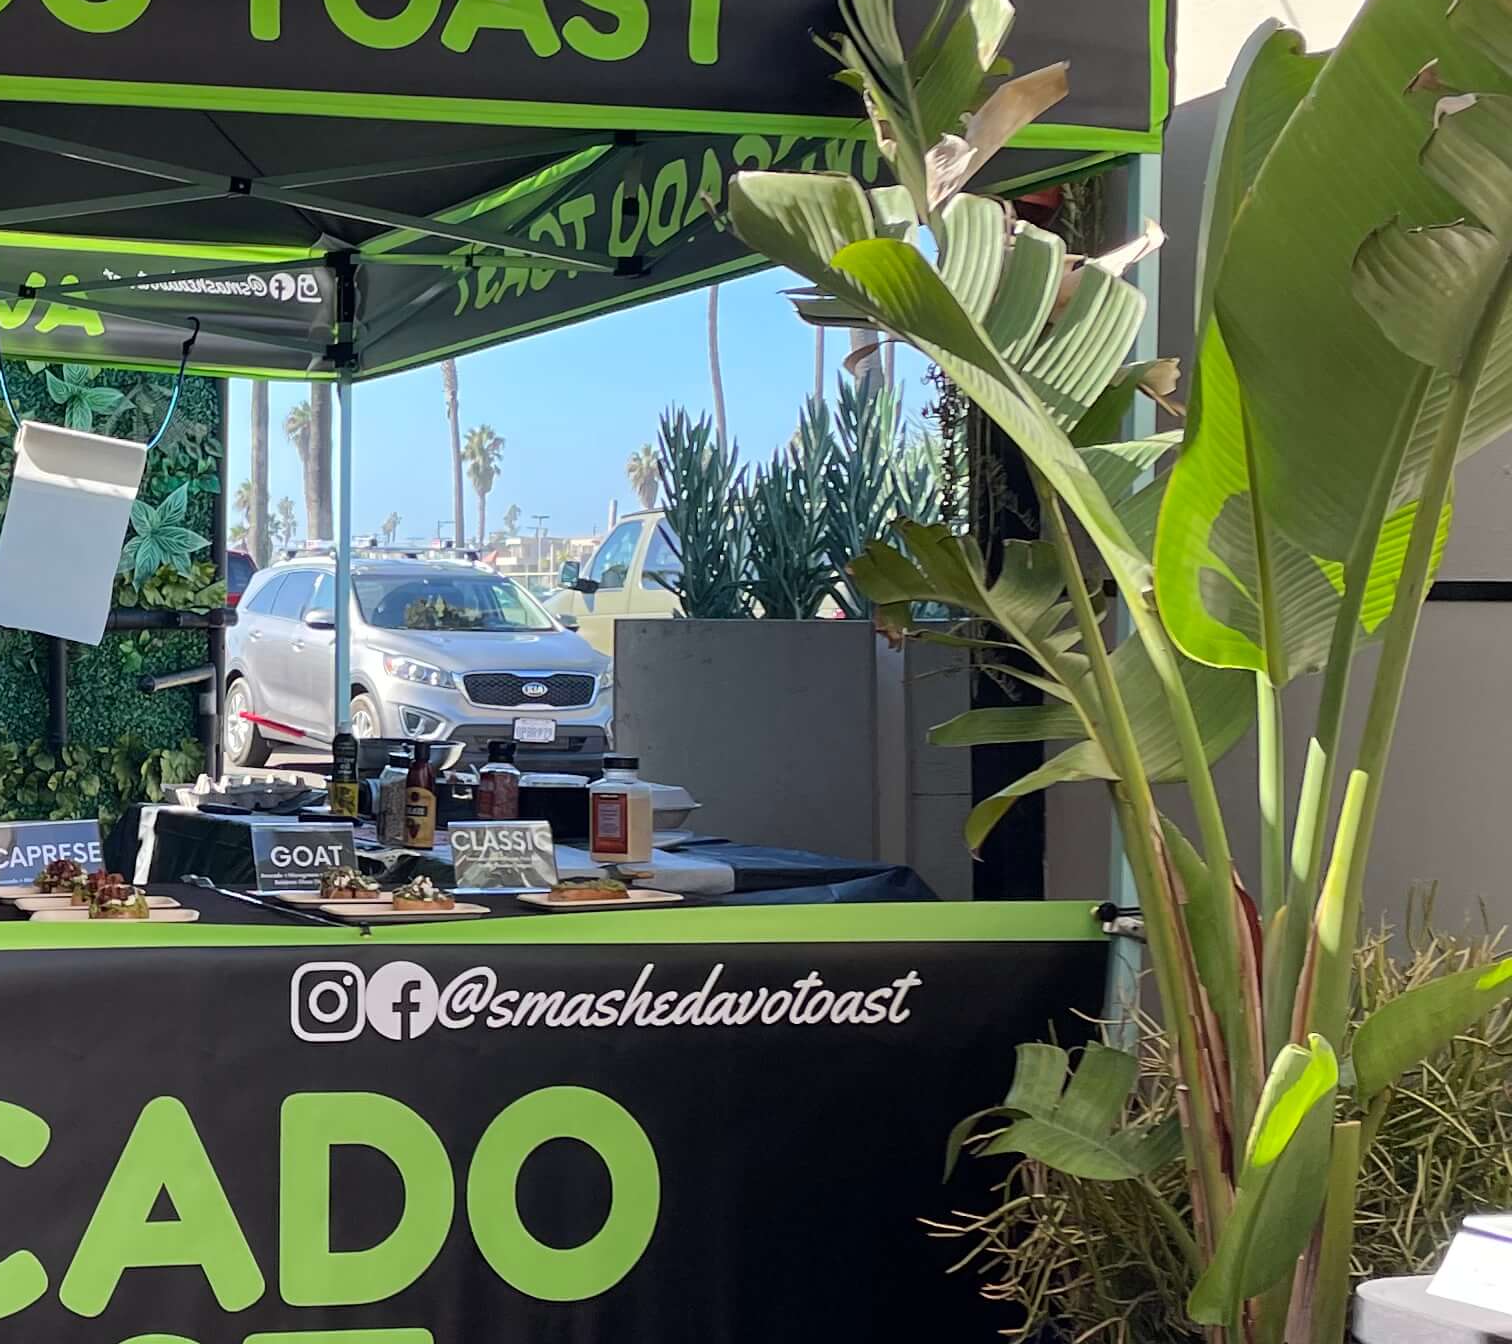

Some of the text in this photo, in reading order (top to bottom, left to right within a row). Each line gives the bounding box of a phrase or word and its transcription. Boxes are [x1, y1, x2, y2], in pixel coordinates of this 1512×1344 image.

[451, 830, 552, 852] CLASSIC
[270, 845, 343, 867] GOAT
[439, 963, 922, 1029] @smashedavotoast
